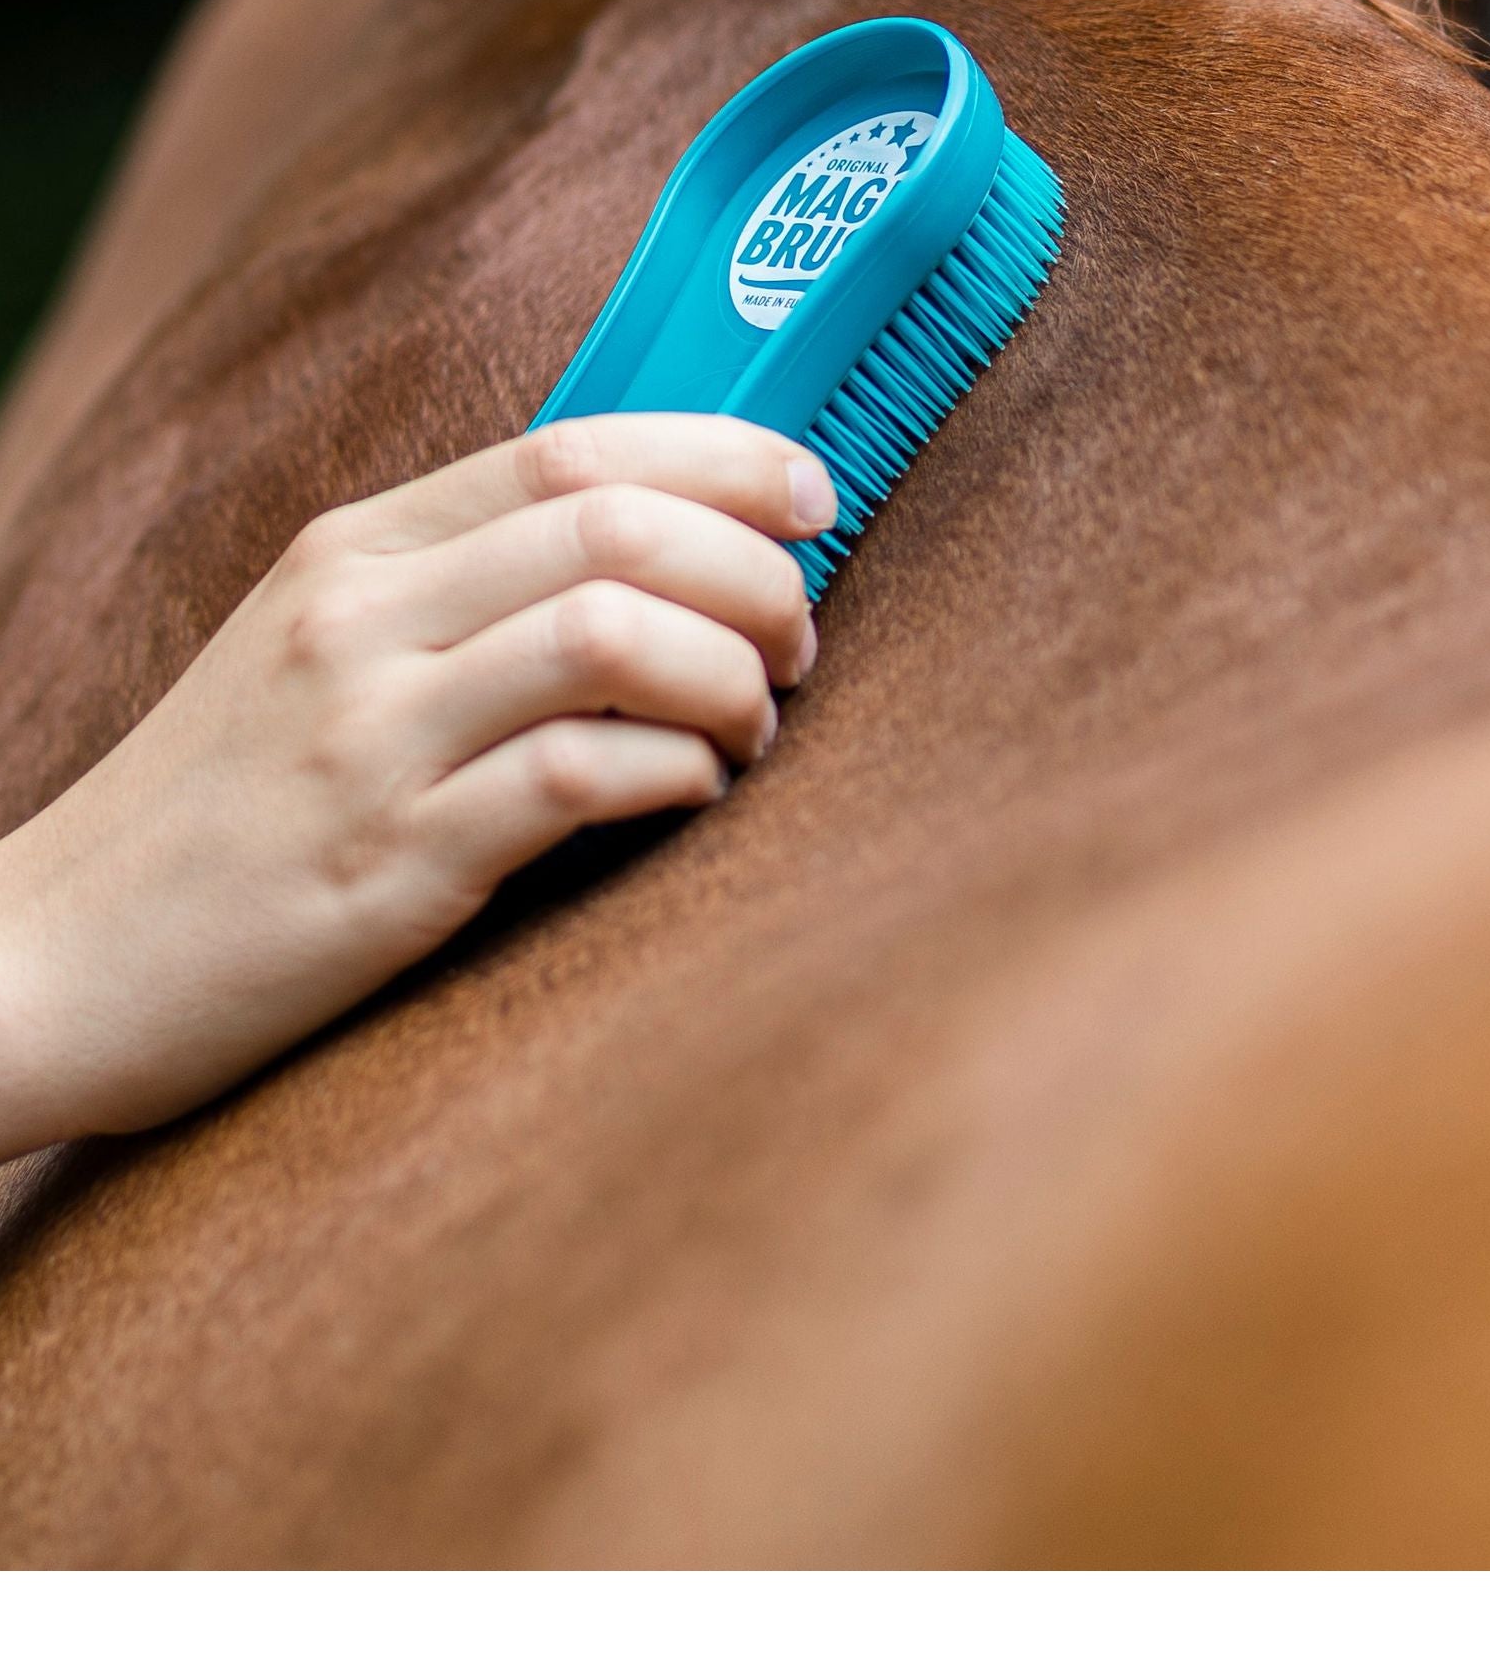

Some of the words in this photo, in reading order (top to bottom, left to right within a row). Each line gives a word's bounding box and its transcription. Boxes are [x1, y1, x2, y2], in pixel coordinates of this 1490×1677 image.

[825, 158, 889, 175] ORIGINAL
[769, 173, 900, 224] MAG
[736, 220, 860, 271] BRU
[741, 294, 773, 307] MADE
[771, 297, 786, 308] IN
[784, 297, 800, 309] EU
